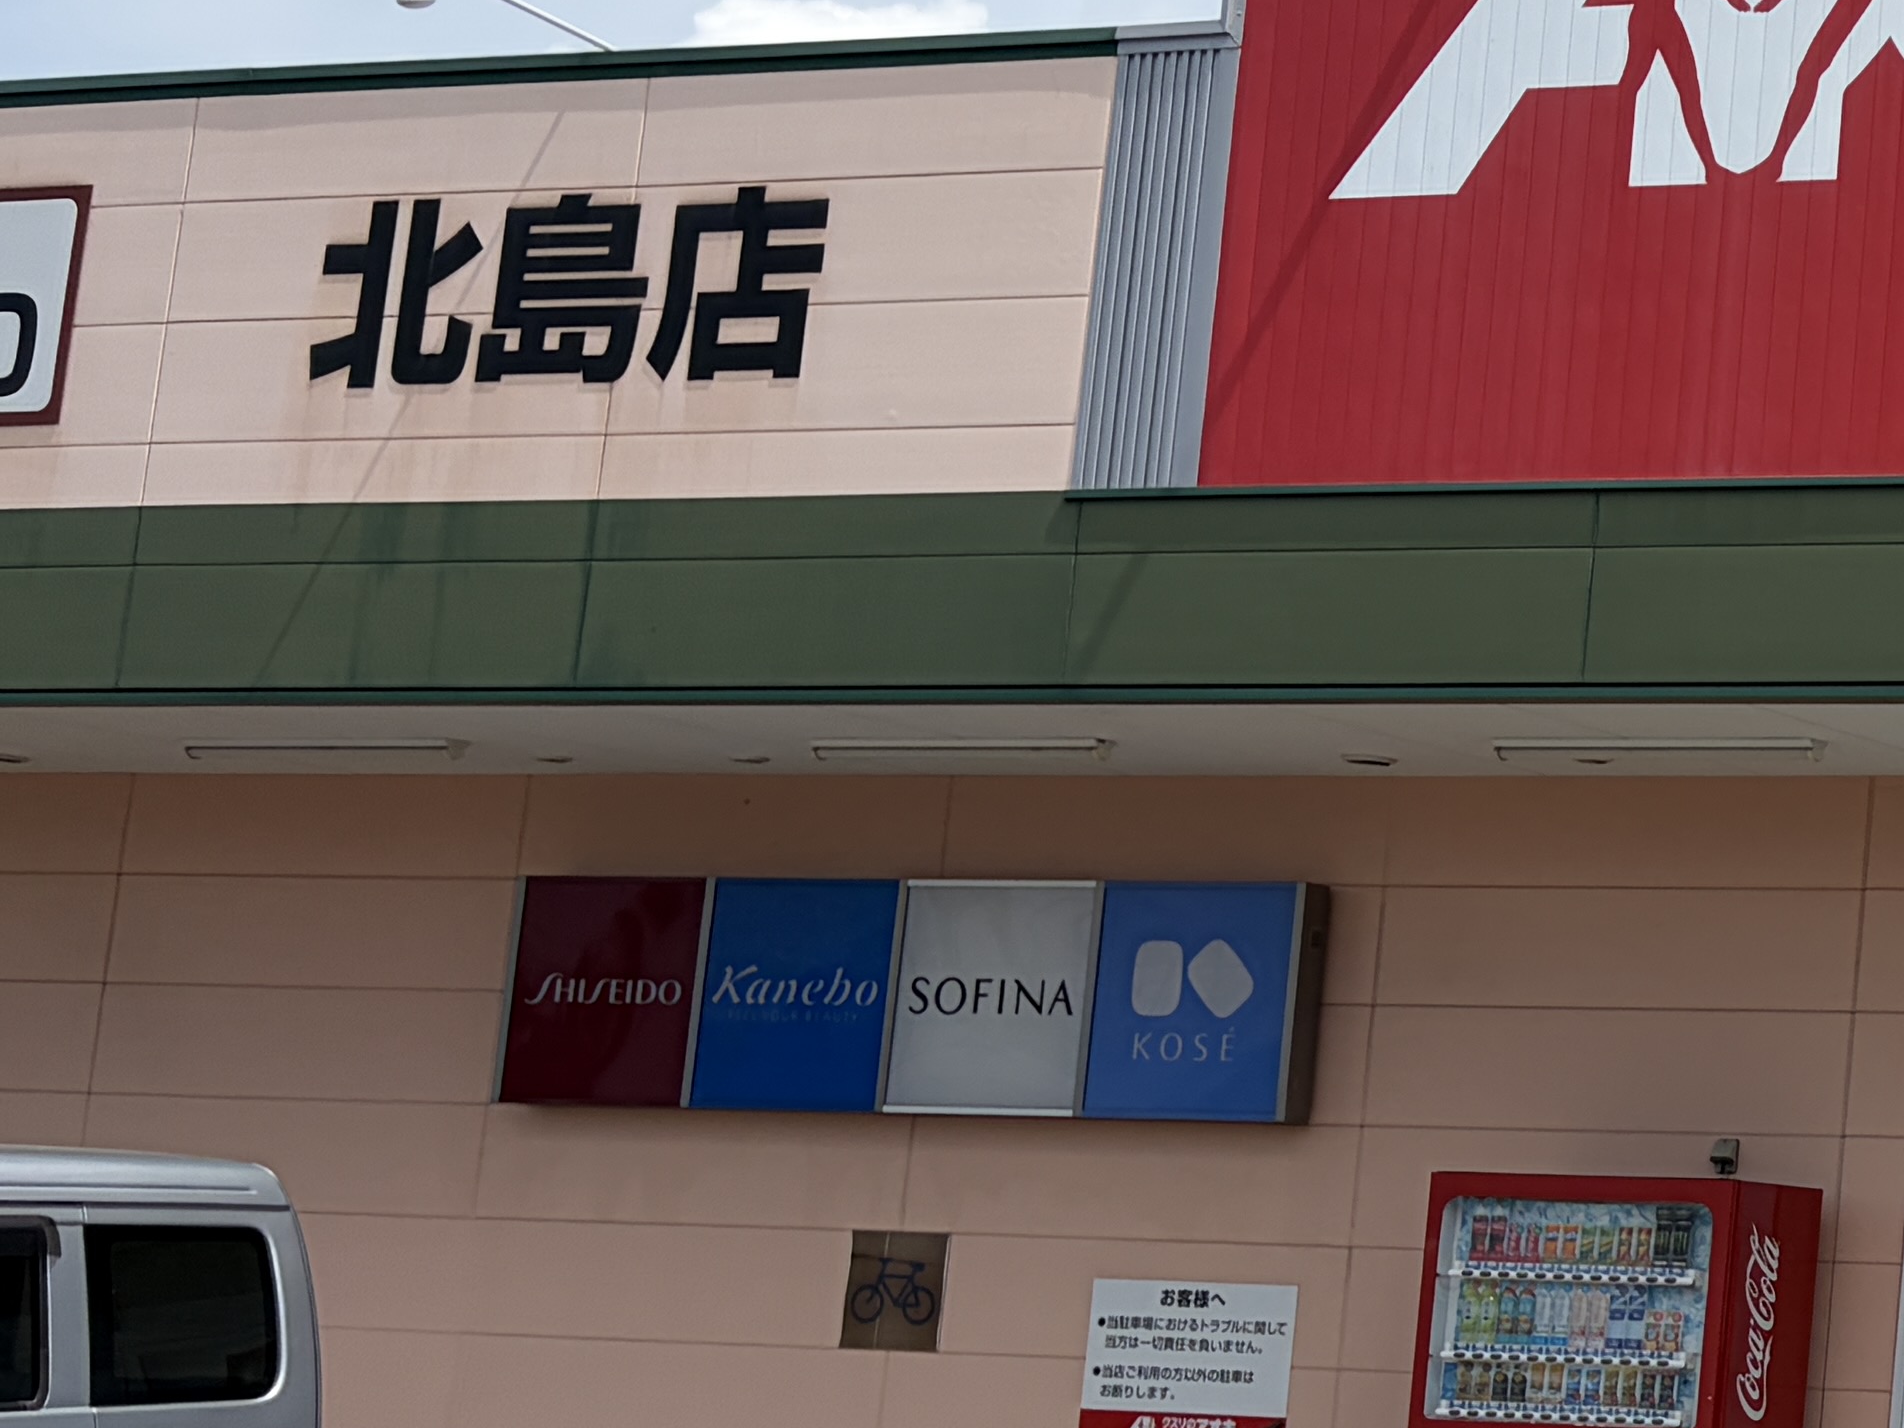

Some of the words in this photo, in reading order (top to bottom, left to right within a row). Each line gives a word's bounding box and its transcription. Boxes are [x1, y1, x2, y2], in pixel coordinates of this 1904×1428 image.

[310, 187, 828, 388] 北島店
[524, 972, 682, 1006] SHISEIDO
[712, 964, 879, 1007] Kanebo
[908, 977, 1073, 1016] SOFINA
[1132, 1027, 1236, 1062] KOSÉ
[1160, 1289, 1226, 1308] お客様へ
